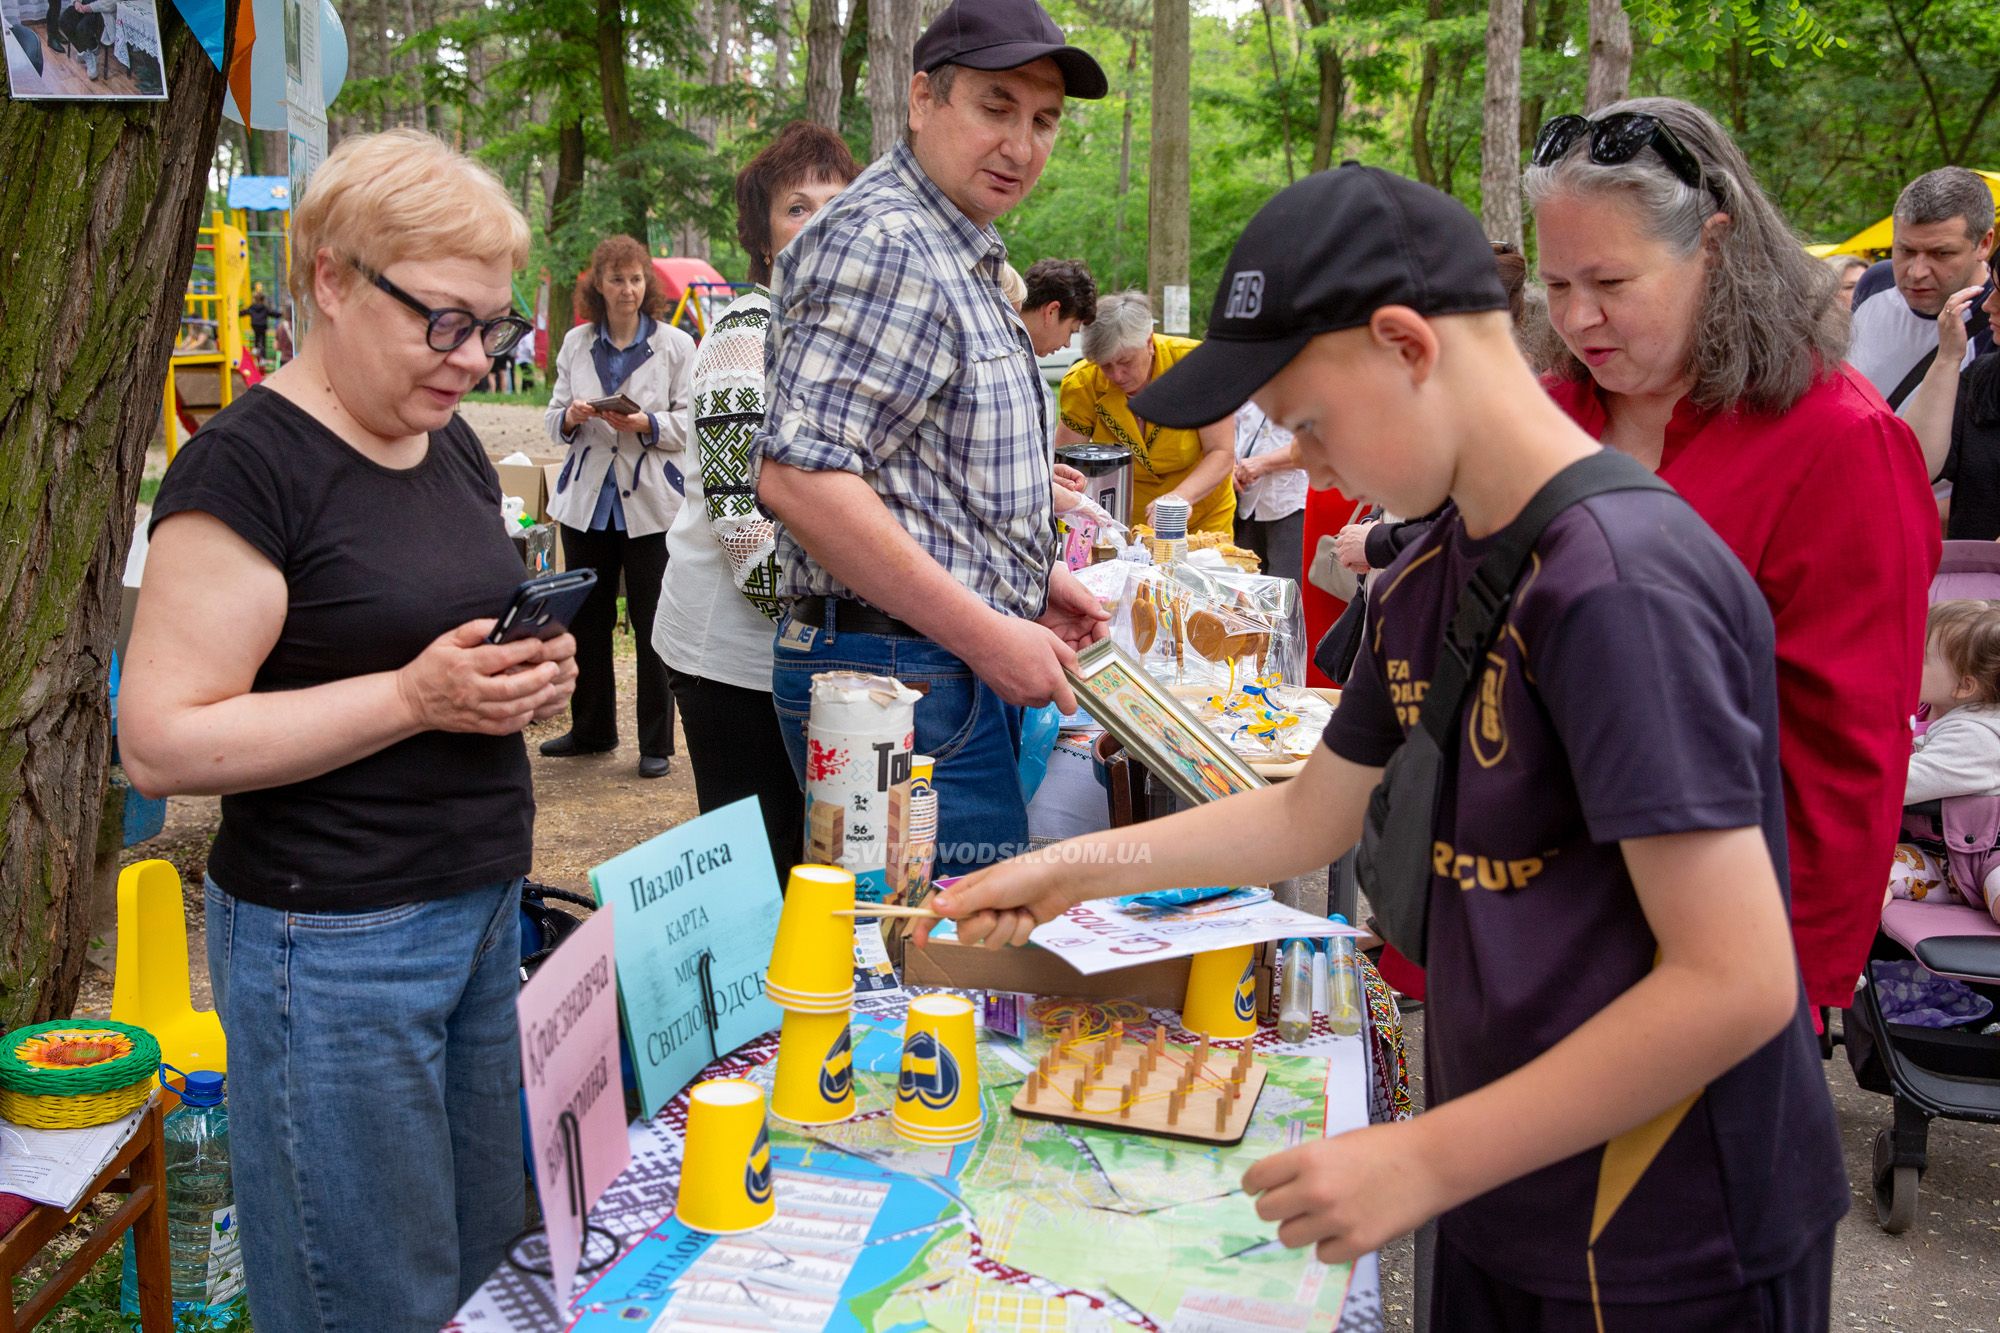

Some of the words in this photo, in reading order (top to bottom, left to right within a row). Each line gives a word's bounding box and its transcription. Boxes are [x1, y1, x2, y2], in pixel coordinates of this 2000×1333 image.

[853, 825, 868, 834] 56
[629, 842, 733, 913] ПазлоТека
[1432, 841, 1543, 891] RCUP
[665, 905, 710, 946] КАРТА
